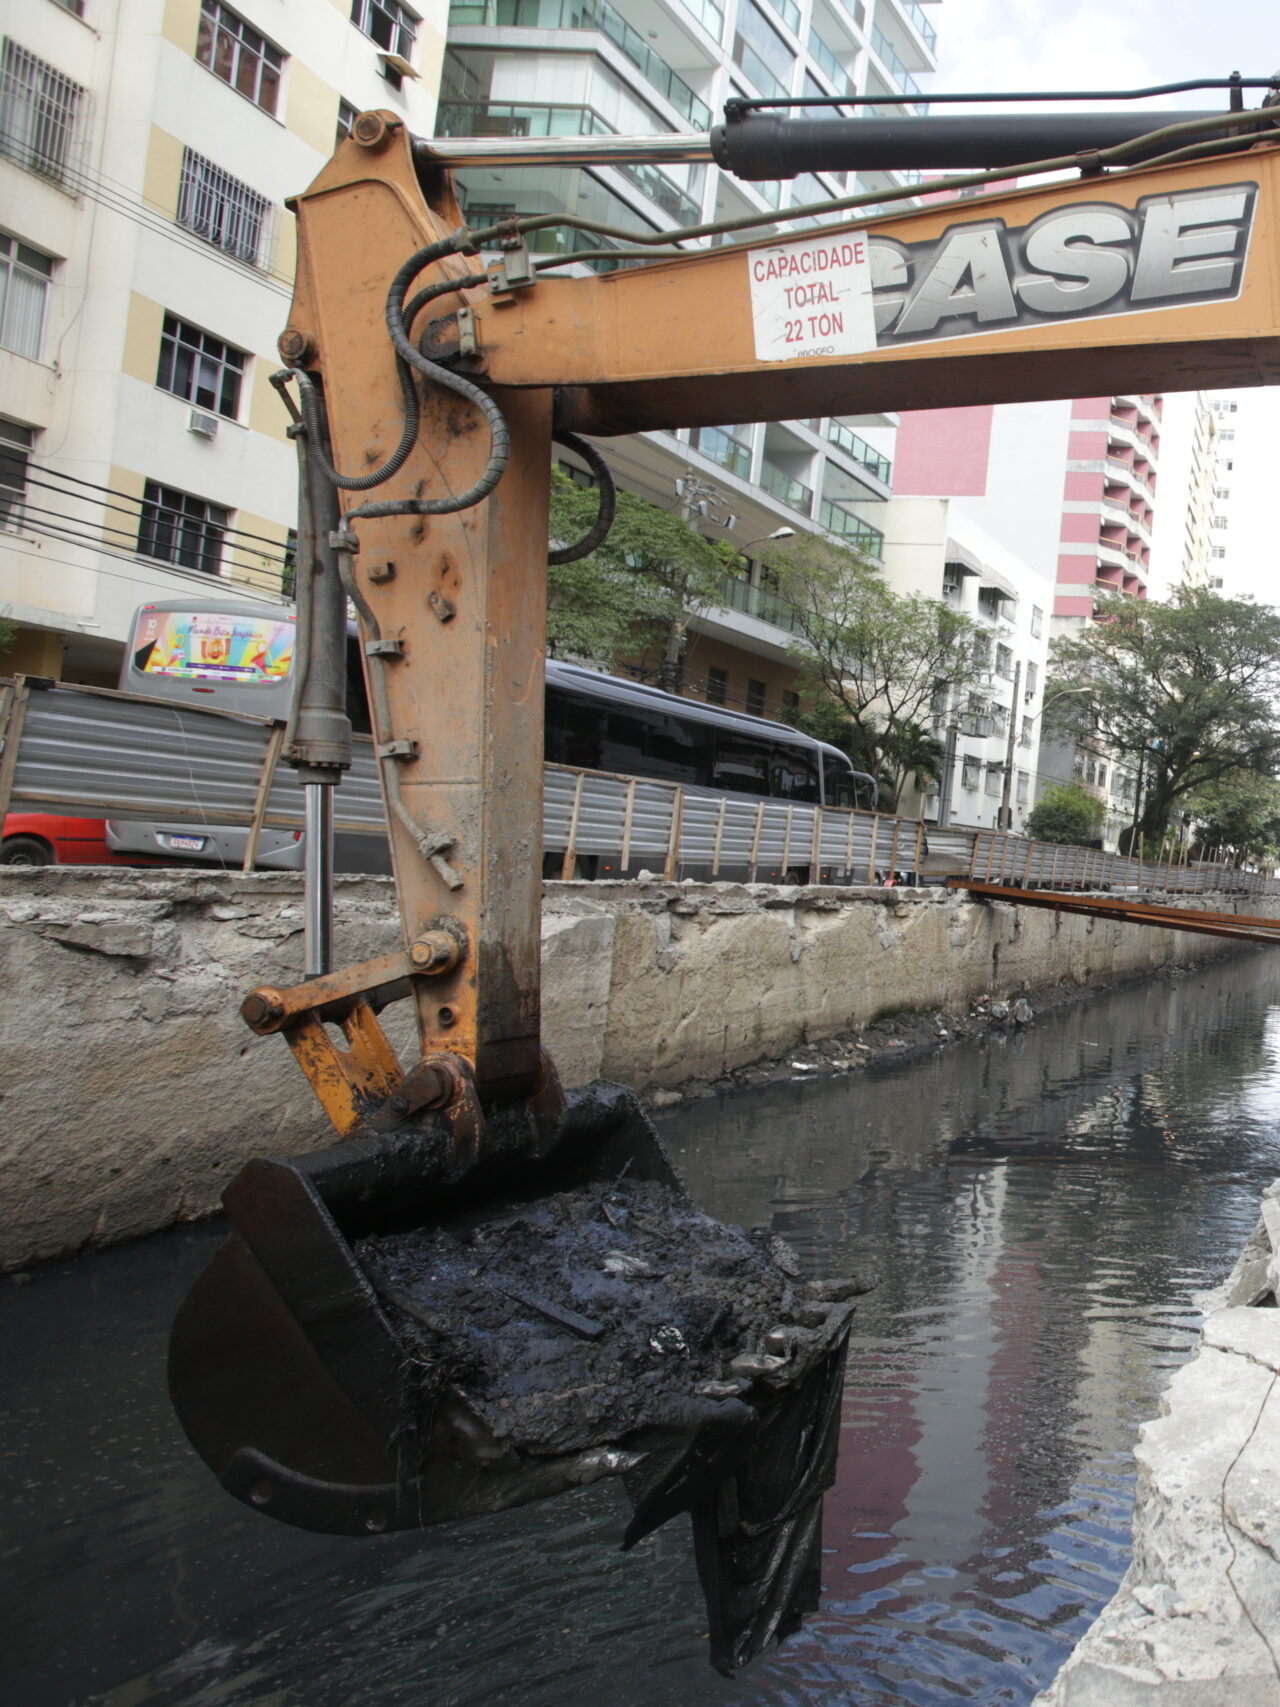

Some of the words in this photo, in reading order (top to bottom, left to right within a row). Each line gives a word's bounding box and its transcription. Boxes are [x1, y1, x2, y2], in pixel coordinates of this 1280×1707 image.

[783, 281, 840, 310] TOTAL
[784, 319, 804, 343] 22
[807, 311, 844, 339] TON
